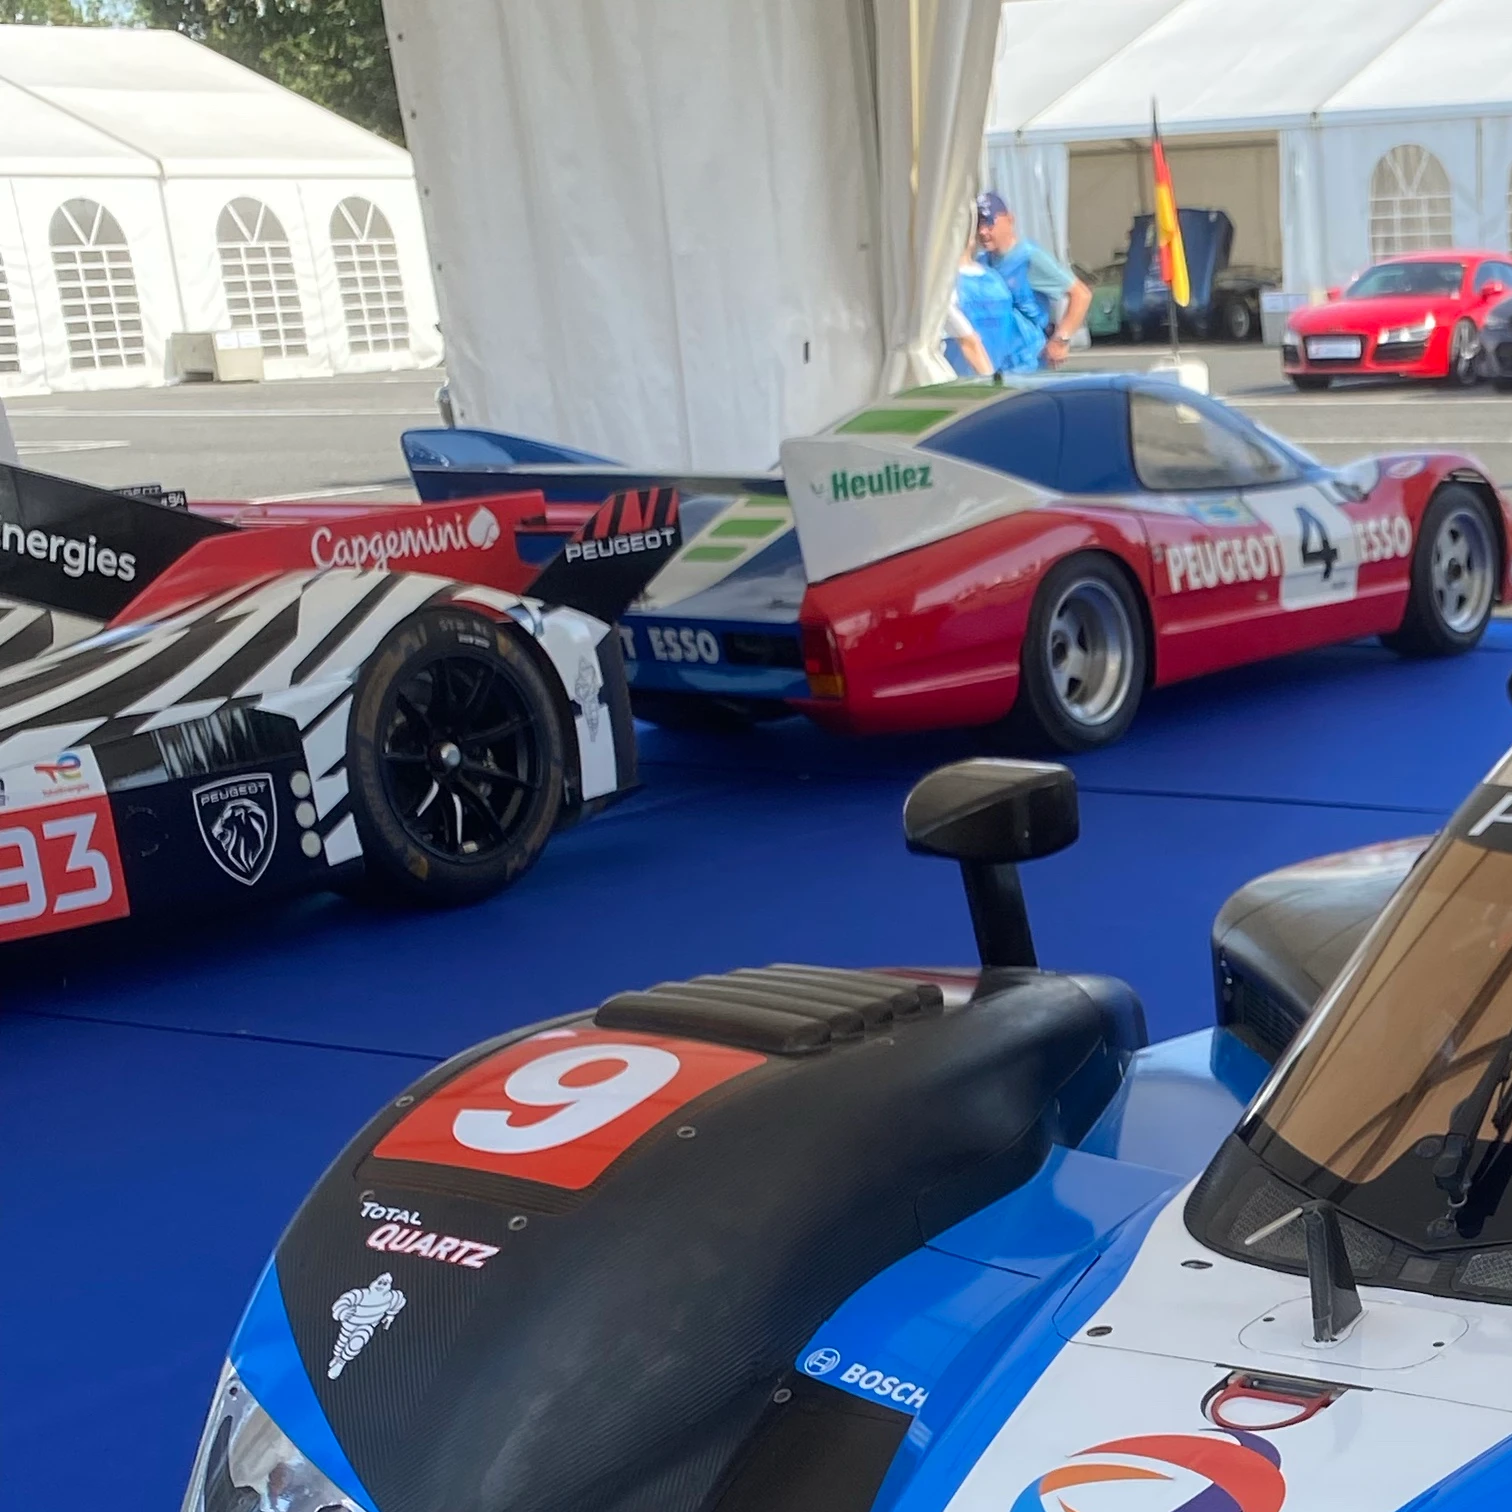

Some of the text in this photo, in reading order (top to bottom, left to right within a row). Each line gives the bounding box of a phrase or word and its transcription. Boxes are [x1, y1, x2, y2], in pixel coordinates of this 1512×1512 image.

[831, 462, 933, 501] Heuliez
[310, 514, 466, 571] Capgemini
[565, 527, 676, 563] PEUGEOT
[1293, 506, 1339, 582] 4
[1353, 515, 1412, 563] ESSO
[1165, 535, 1282, 594] PEUGEOT
[646, 626, 720, 664] ESSO
[200, 781, 267, 806] PEUGEOT
[0, 812, 113, 925] 93
[452, 1043, 681, 1154] 9
[360, 1201, 423, 1226] TOTAL
[366, 1223, 502, 1269] QUARTZ
[840, 1363, 931, 1409] BOSCH
